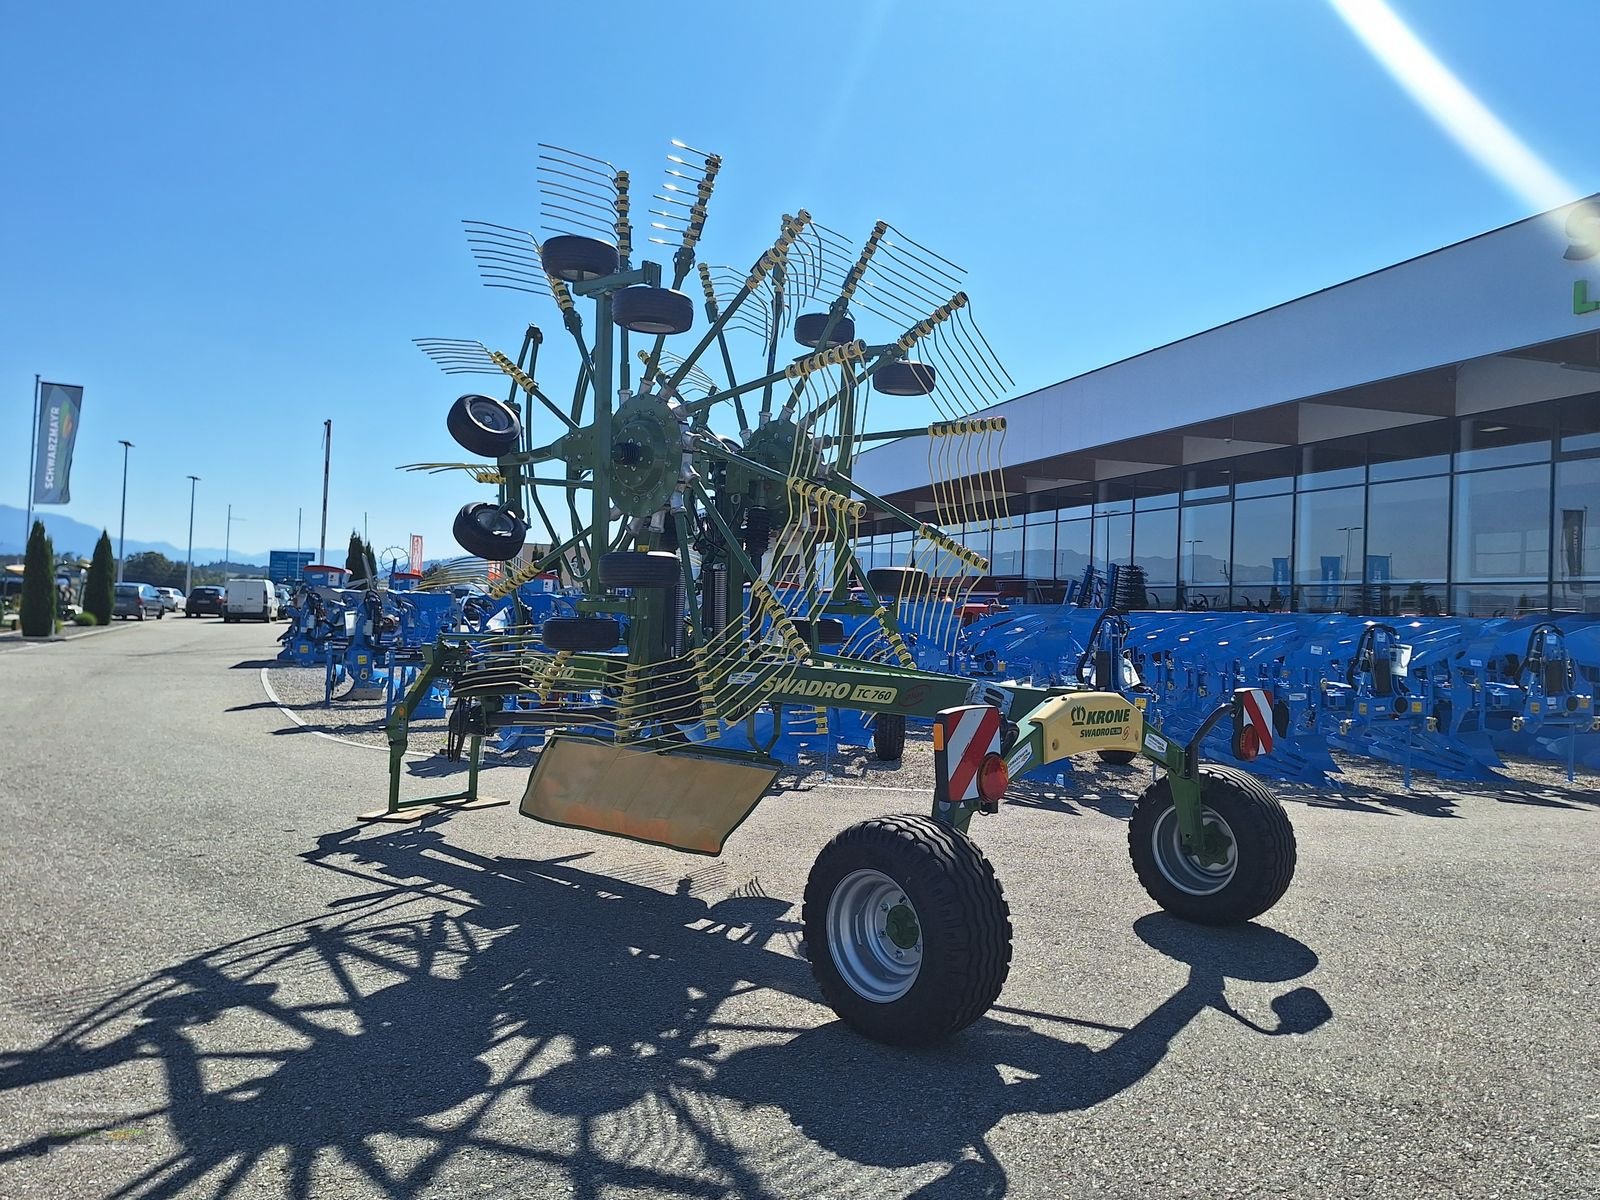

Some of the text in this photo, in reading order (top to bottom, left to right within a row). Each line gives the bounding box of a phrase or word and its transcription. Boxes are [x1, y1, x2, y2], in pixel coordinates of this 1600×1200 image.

[45, 407, 60, 489] SCHWARZMAYR
[760, 676, 851, 700] SWADRO
[856, 688, 869, 699] TC
[871, 689, 892, 701] 760
[1086, 708, 1131, 725] KRONE
[1080, 727, 1110, 738] SWADRO
